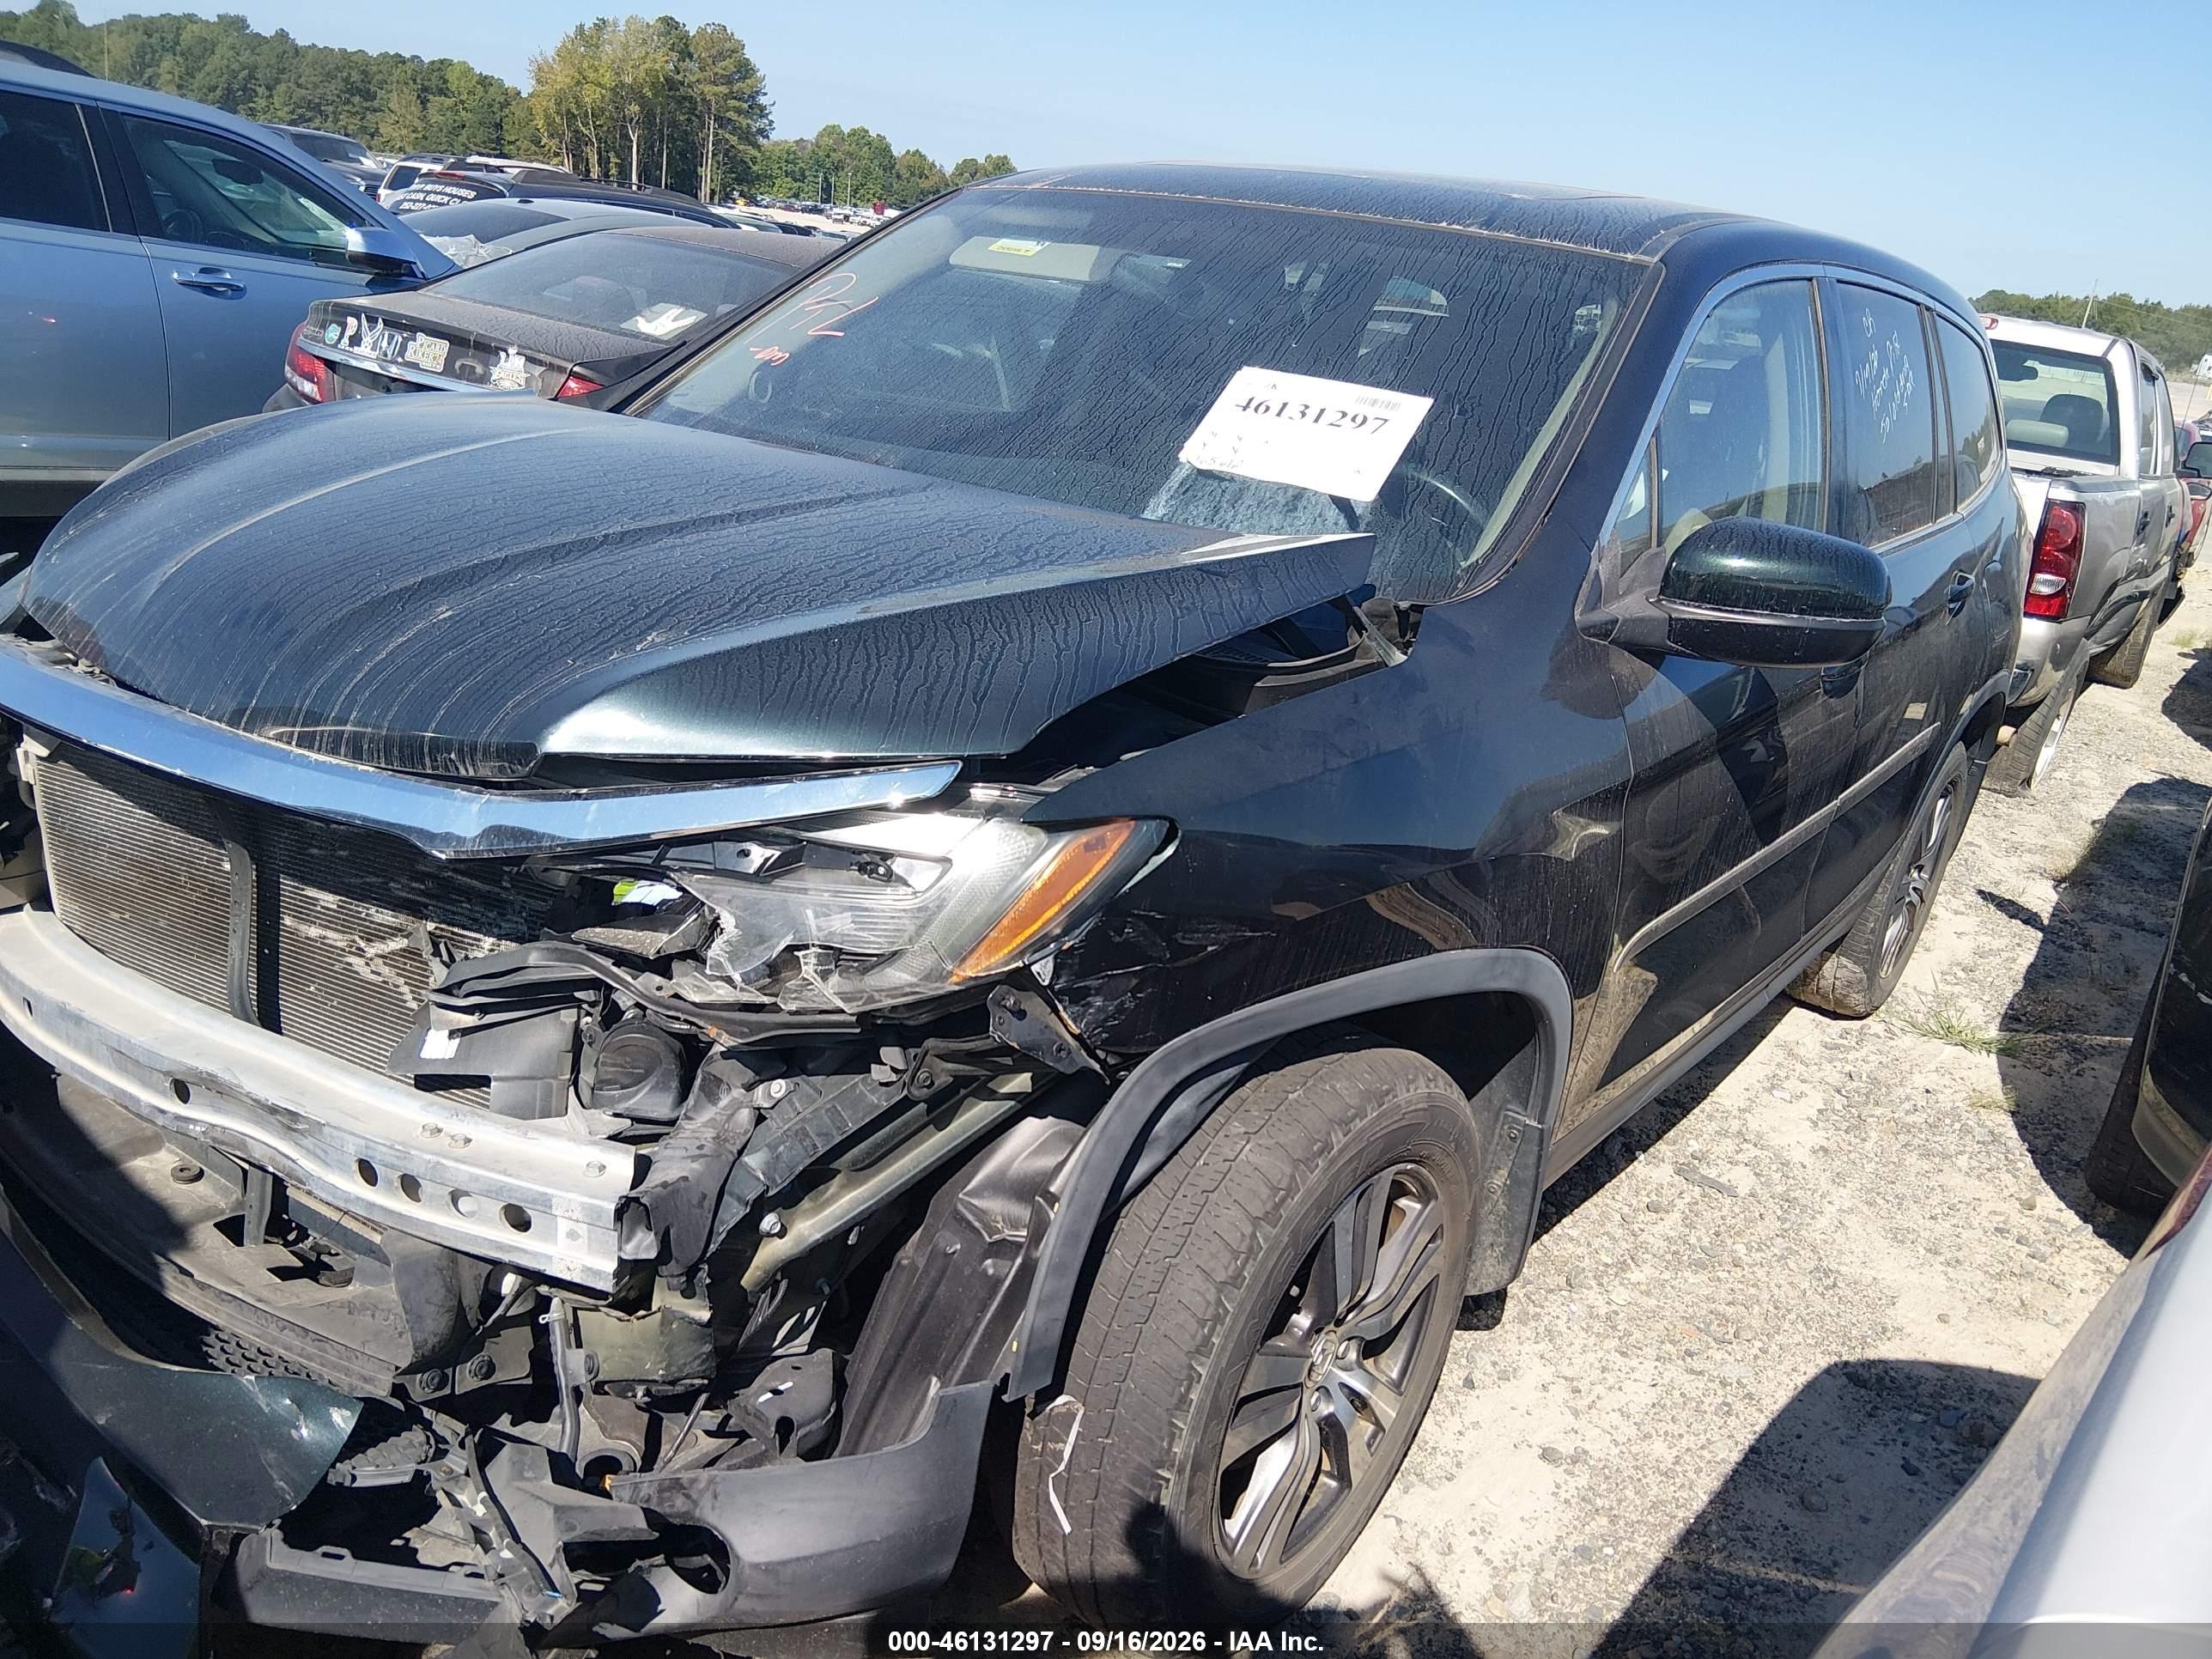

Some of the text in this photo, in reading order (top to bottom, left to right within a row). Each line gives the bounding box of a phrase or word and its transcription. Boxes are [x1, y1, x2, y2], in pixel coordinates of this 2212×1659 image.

[422, 184, 446, 192] BUYS
[441, 185, 477, 199] HOUSES
[425, 193, 453, 204] QUICK
[416, 335, 447, 354] PICARD
[1235, 396, 1389, 434] 46131297
